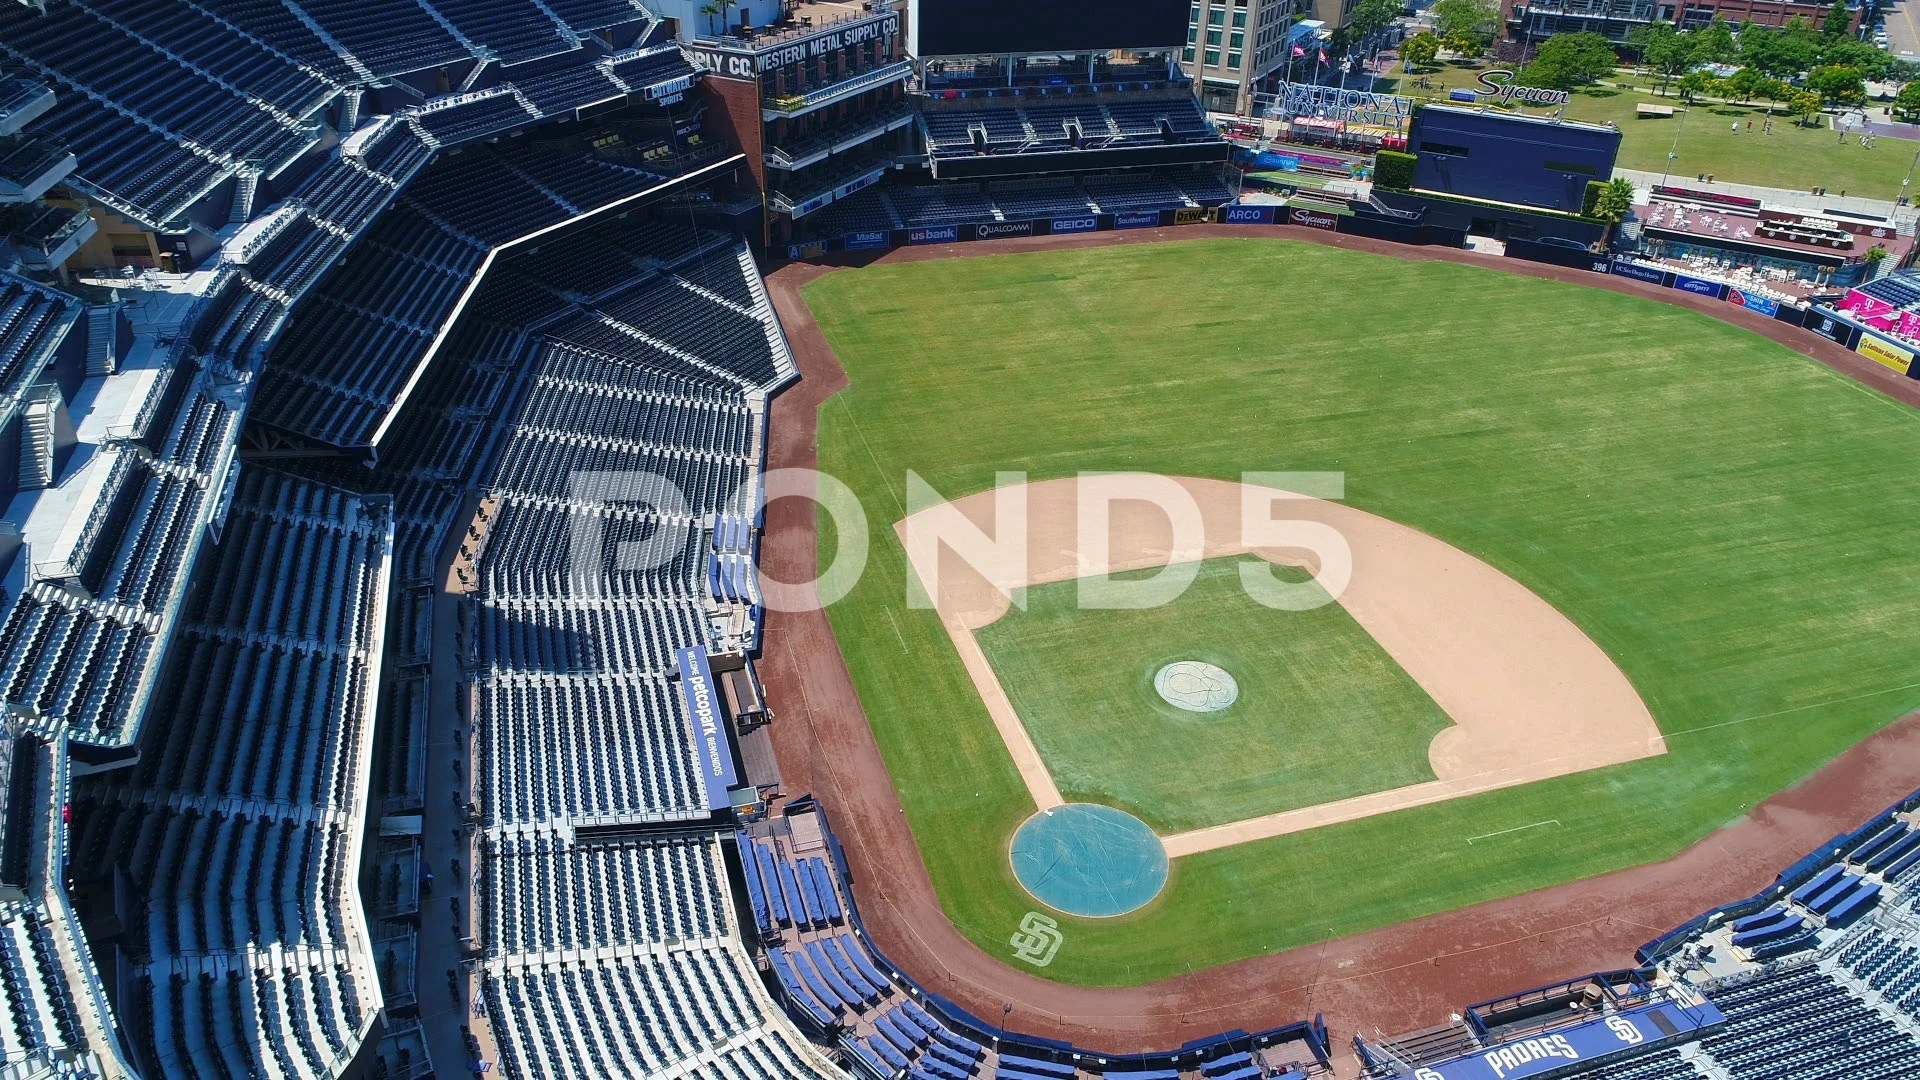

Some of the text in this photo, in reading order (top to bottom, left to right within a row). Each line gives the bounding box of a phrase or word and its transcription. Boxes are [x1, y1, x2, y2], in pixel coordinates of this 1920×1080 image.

[757, 17, 898, 73] WESTERN METAL SUPPLY CO.
[728, 56, 755, 78] CO.
[1473, 69, 1570, 106] Sycuan
[659, 92, 684, 107] SPIRITS
[1286, 99, 1406, 128] UNIVERSITY
[1117, 216, 1151, 225] Southwest
[1228, 209, 1261, 220] ARCO
[1291, 210, 1332, 226] Sycuan
[1053, 218, 1096, 230] GEICO
[1592, 262, 1607, 273] 396
[1623, 266, 1631, 274] San
[1632, 269, 1644, 277] Diego
[1684, 281, 1709, 292] ampm
[1867, 343, 1910, 366] Sullivan Solar Power
[687, 651, 700, 676] WELCOME
[1484, 1034, 1579, 1079] PADRES
